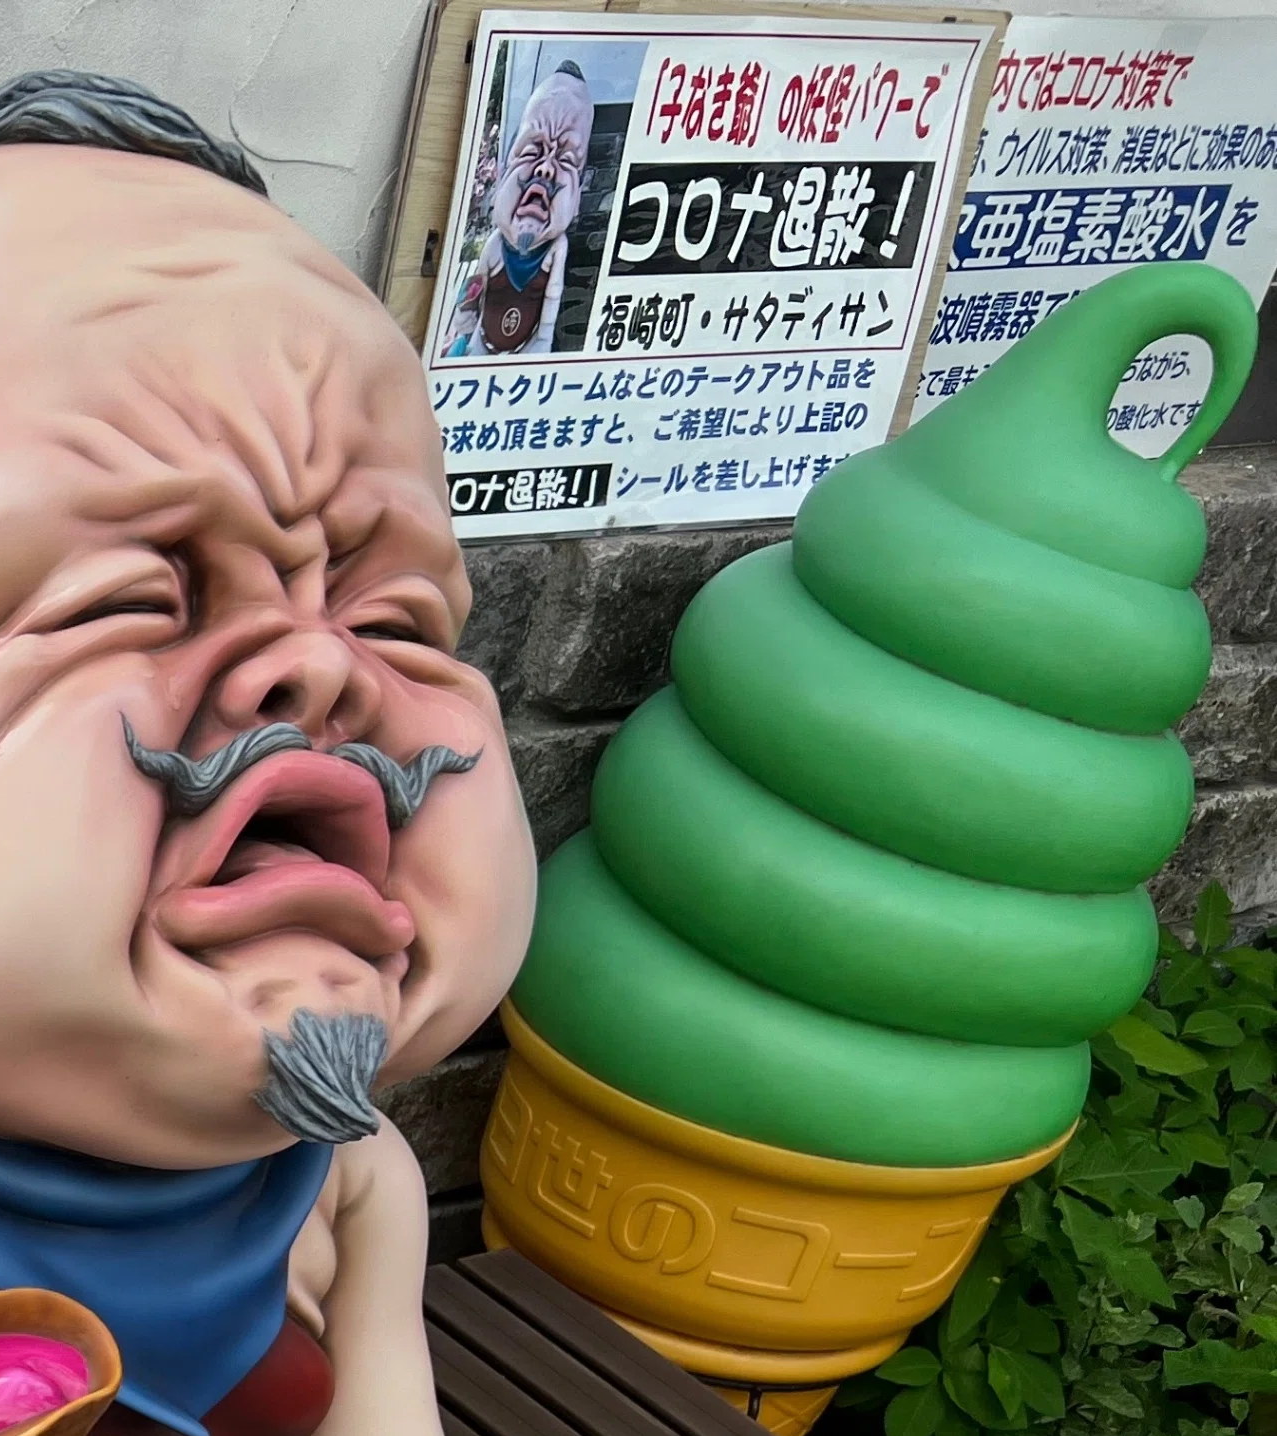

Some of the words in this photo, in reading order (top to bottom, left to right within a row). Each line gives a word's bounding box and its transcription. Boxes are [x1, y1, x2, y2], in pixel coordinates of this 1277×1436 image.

[646, 57, 950, 148] 「子なき爺」の妖怪パワーで
[970, 123, 1277, 178] 、ウイルス対策、消臭などに効果のあ
[1226, 196, 1259, 246] を
[929, 289, 1082, 346] 波噴霧器
[433, 358, 875, 411] ソフトクリームなどのテークアウト品を
[914, 364, 990, 399] で最も
[616, 453, 850, 498] シールを差し上げま
